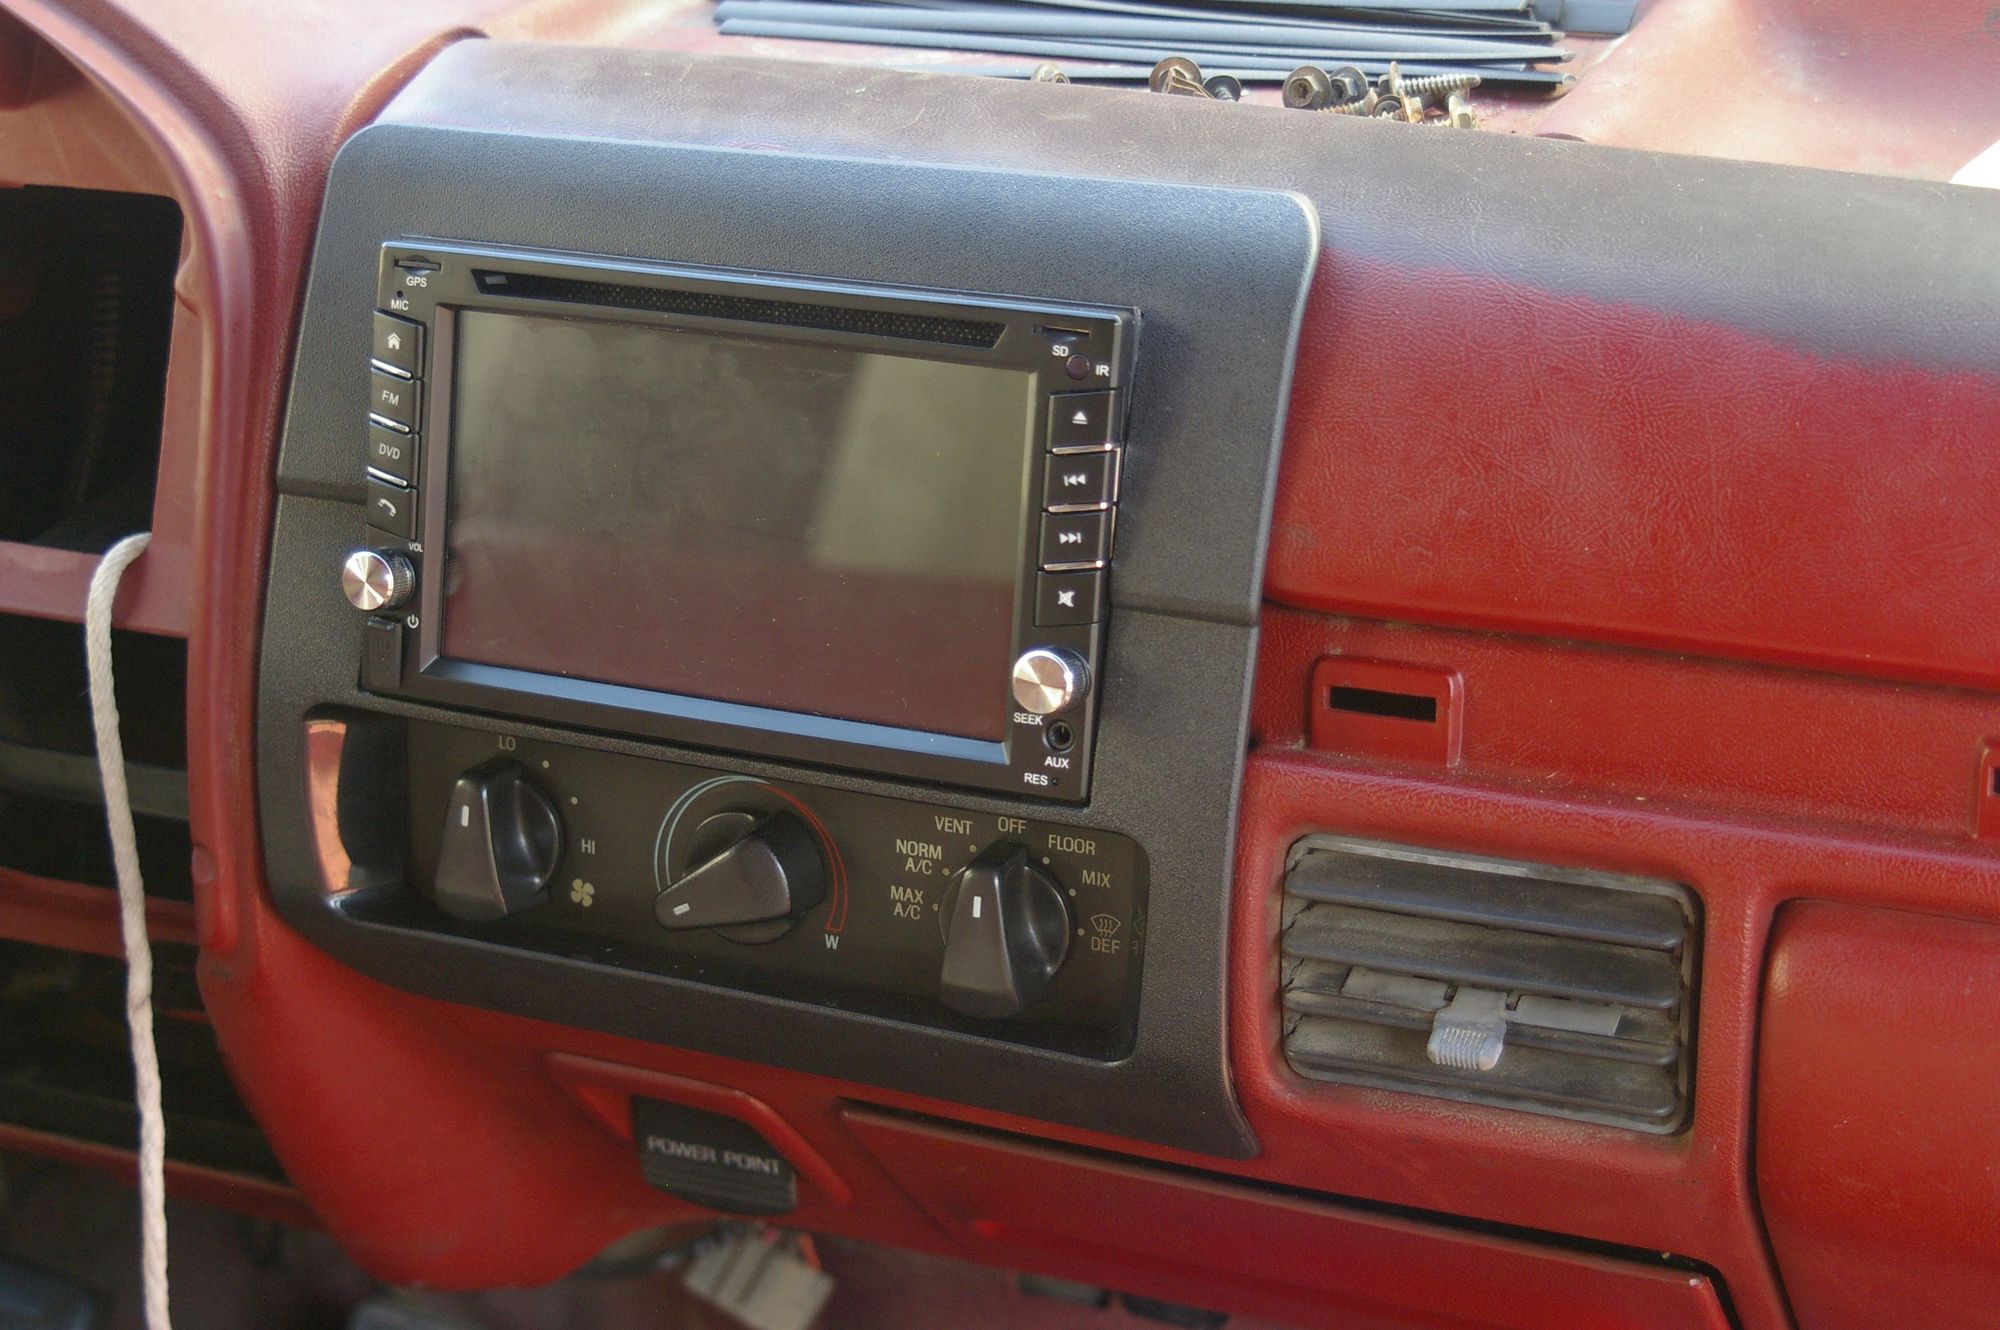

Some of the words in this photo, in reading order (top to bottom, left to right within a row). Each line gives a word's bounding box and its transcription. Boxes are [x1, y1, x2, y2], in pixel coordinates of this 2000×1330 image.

[406, 276, 427, 288] GPS
[391, 299, 409, 311] MIC
[1052, 345, 1069, 357] SD
[1095, 365, 1110, 377] IR
[381, 390, 399, 407] FM
[379, 443, 401, 460] DVD
[408, 542, 424, 553] VOL
[1013, 712, 1043, 726] SEEK
[498, 736, 516, 751] LO
[1044, 756, 1069, 769] AUX
[1024, 772, 1048, 786] RES
[934, 815, 973, 835] VENT
[998, 816, 1027, 835] OFF
[581, 838, 596, 854] HI
[896, 839, 942, 860] NORM
[1048, 834, 1096, 855] FLOOR
[905, 859, 932, 875] A/C
[1082, 869, 1111, 888] MIX
[890, 885, 924, 904] MAX
[894, 903, 921, 920] A/C
[824, 934, 839, 950] W
[1090, 936, 1121, 954] DEF
[648, 1135, 716, 1162] POWER
[723, 1150, 779, 1175] POINT
